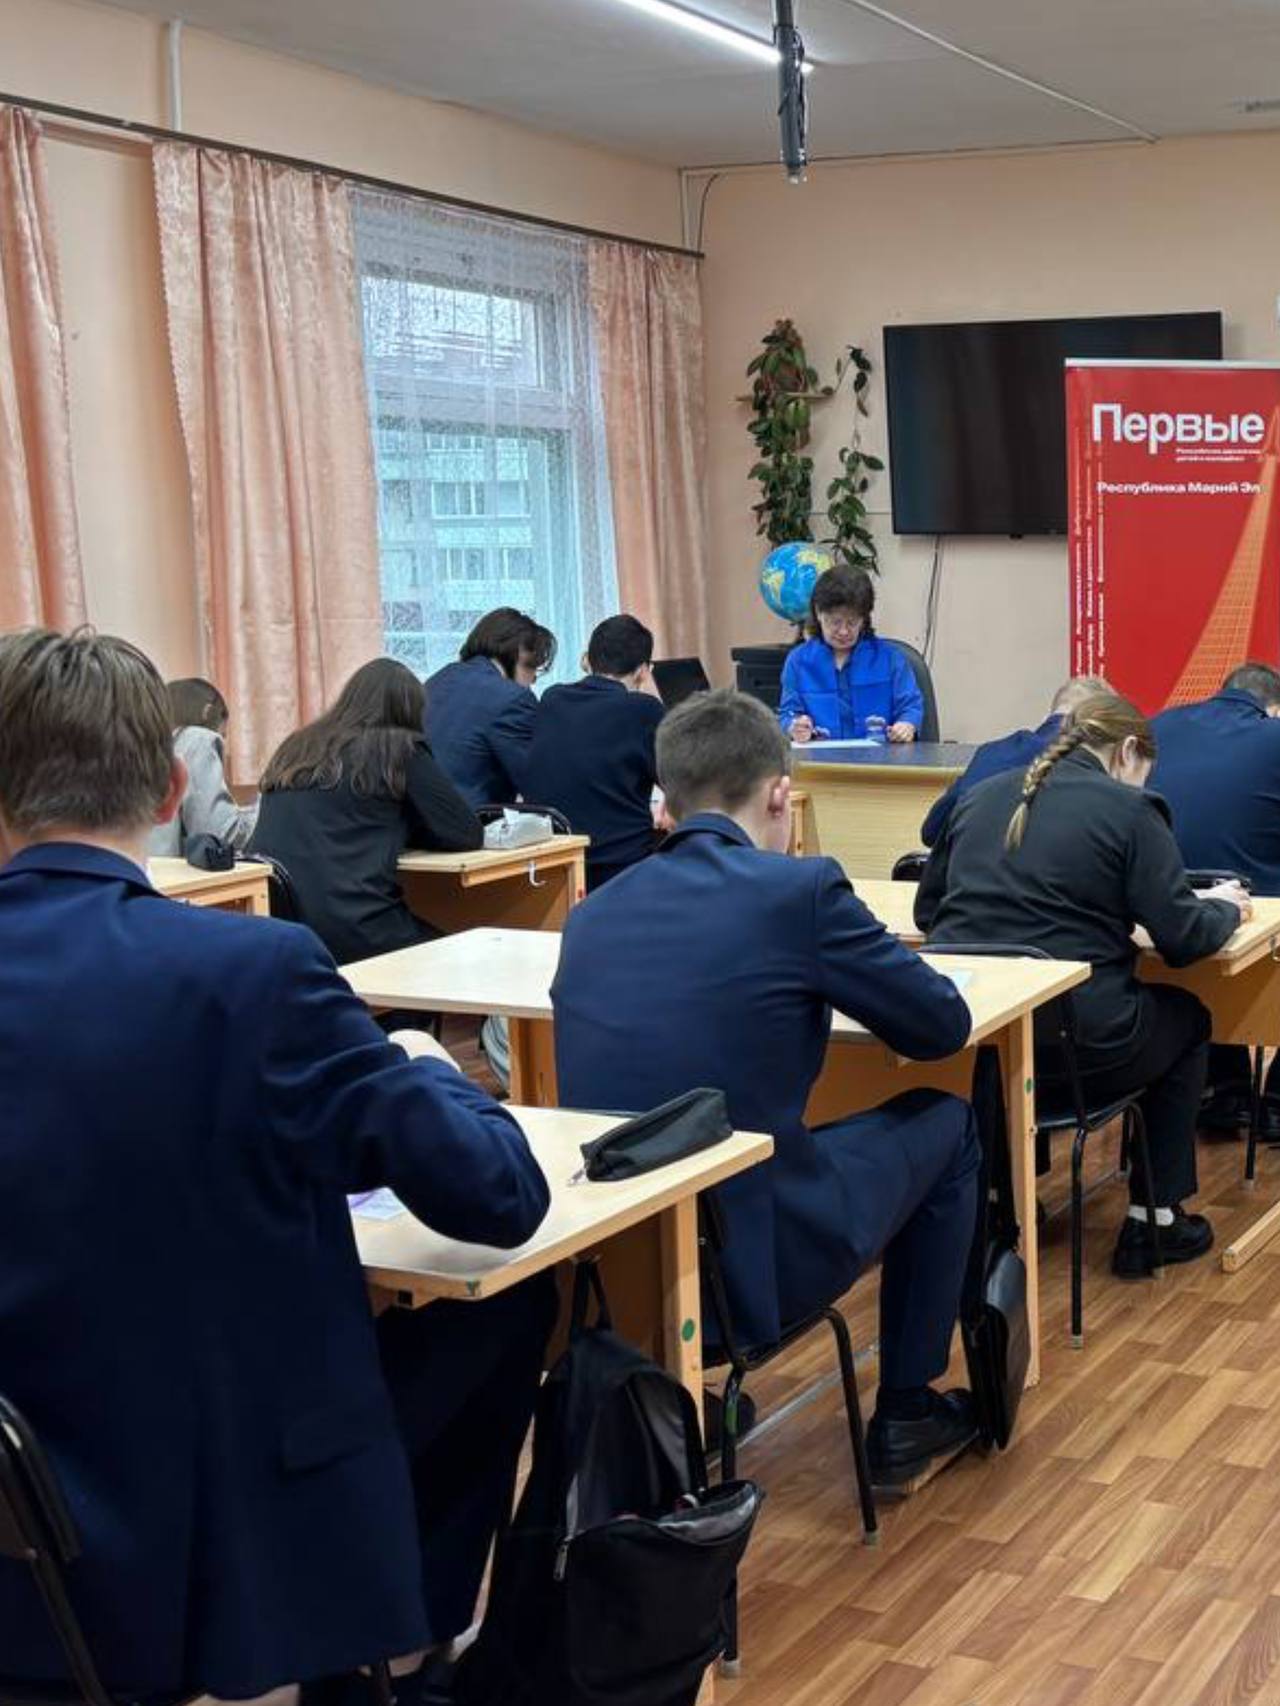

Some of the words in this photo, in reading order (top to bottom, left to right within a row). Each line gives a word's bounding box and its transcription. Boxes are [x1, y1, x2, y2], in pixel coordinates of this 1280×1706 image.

[1091, 403, 1265, 454] Первые
[1097, 481, 1186, 496] Республика
[1187, 481, 1239, 495] Марий
[1239, 481, 1261, 494] Эл
